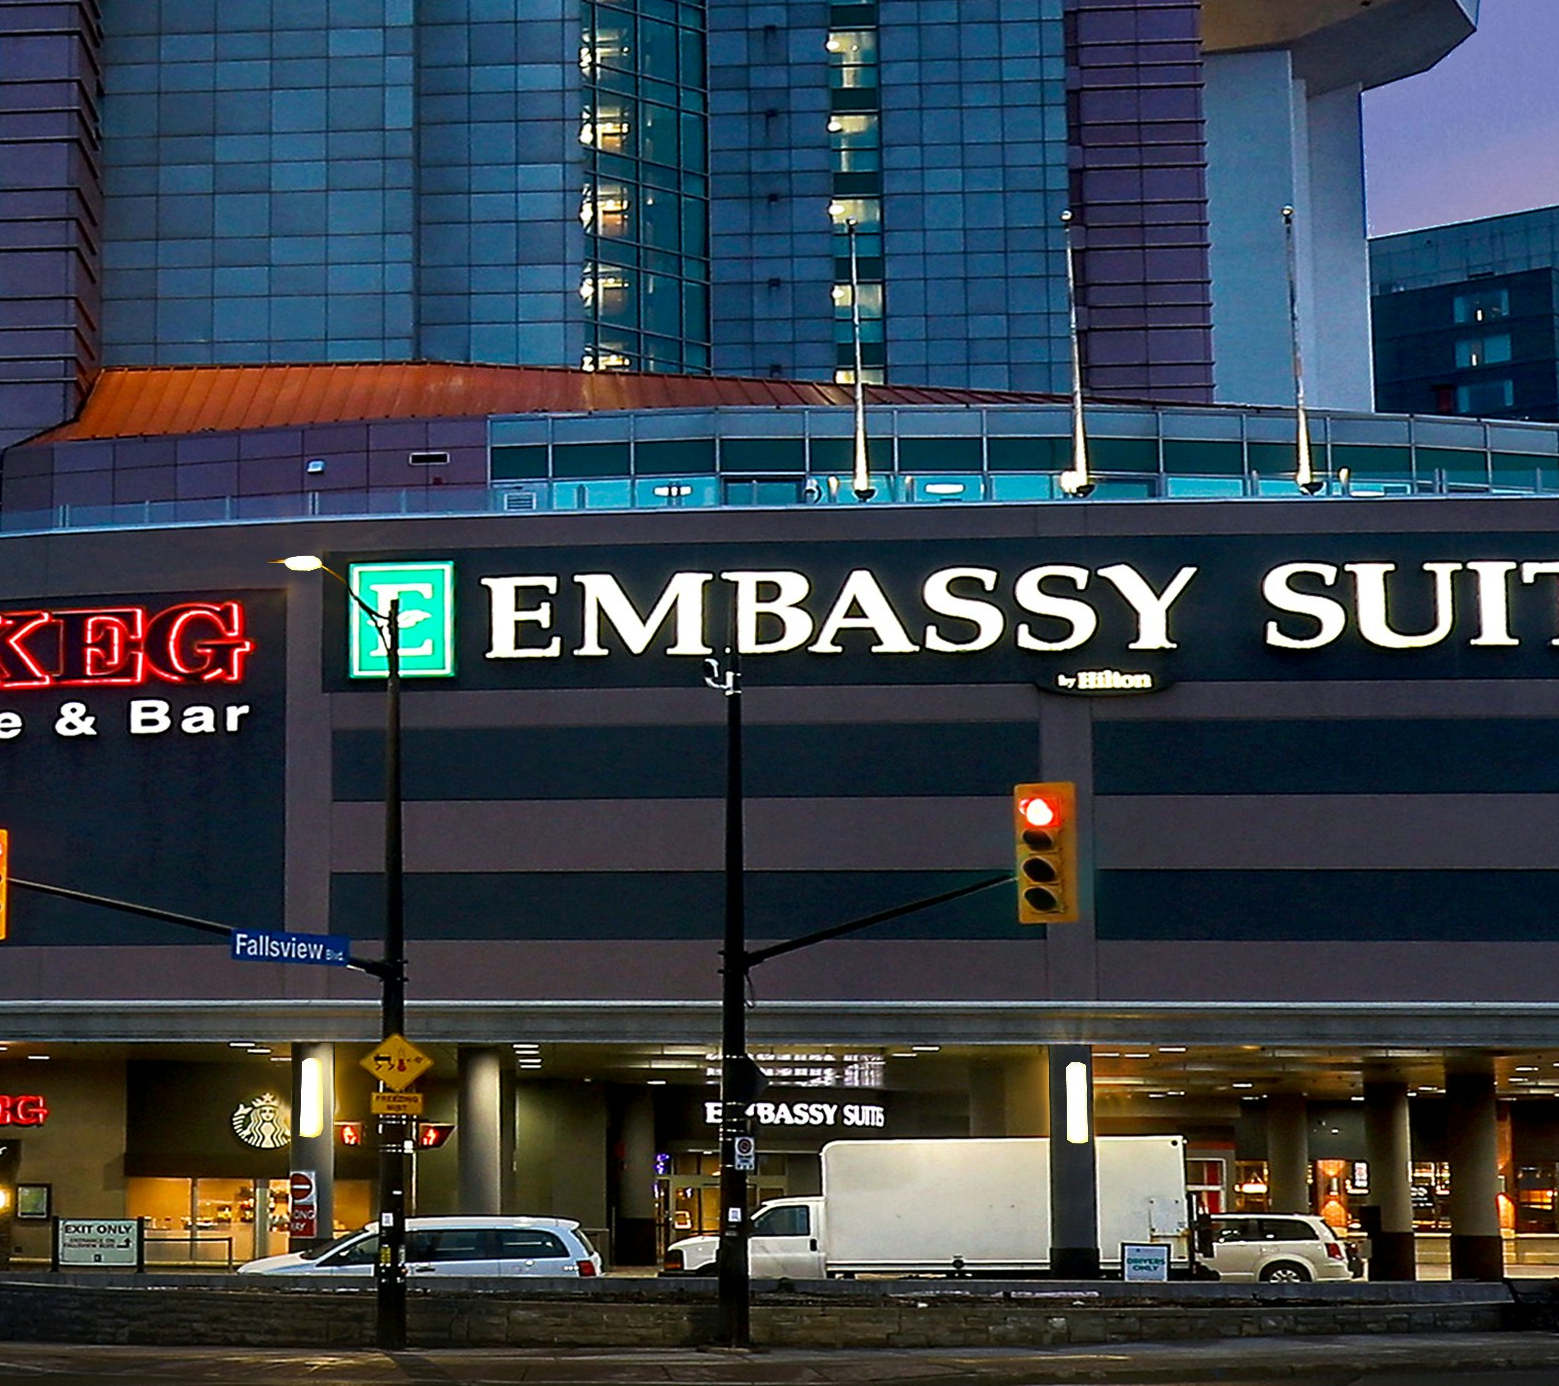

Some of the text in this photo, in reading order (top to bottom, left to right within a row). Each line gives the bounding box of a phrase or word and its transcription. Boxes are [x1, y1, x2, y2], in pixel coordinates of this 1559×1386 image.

[481, 564, 1198, 659] EMBASSY
[1077, 669, 1152, 689] Hilton
[54, 702, 98, 737] &
[129, 699, 251, 734] Bar
[236, 933, 324, 960] Fallsview
[376, 1094, 419, 1104] FREEZING
[386, 1104, 408, 1112] MIST
[704, 1101, 838, 1125] EBASSY
[65, 1224, 132, 1234] EXIT ONLY
